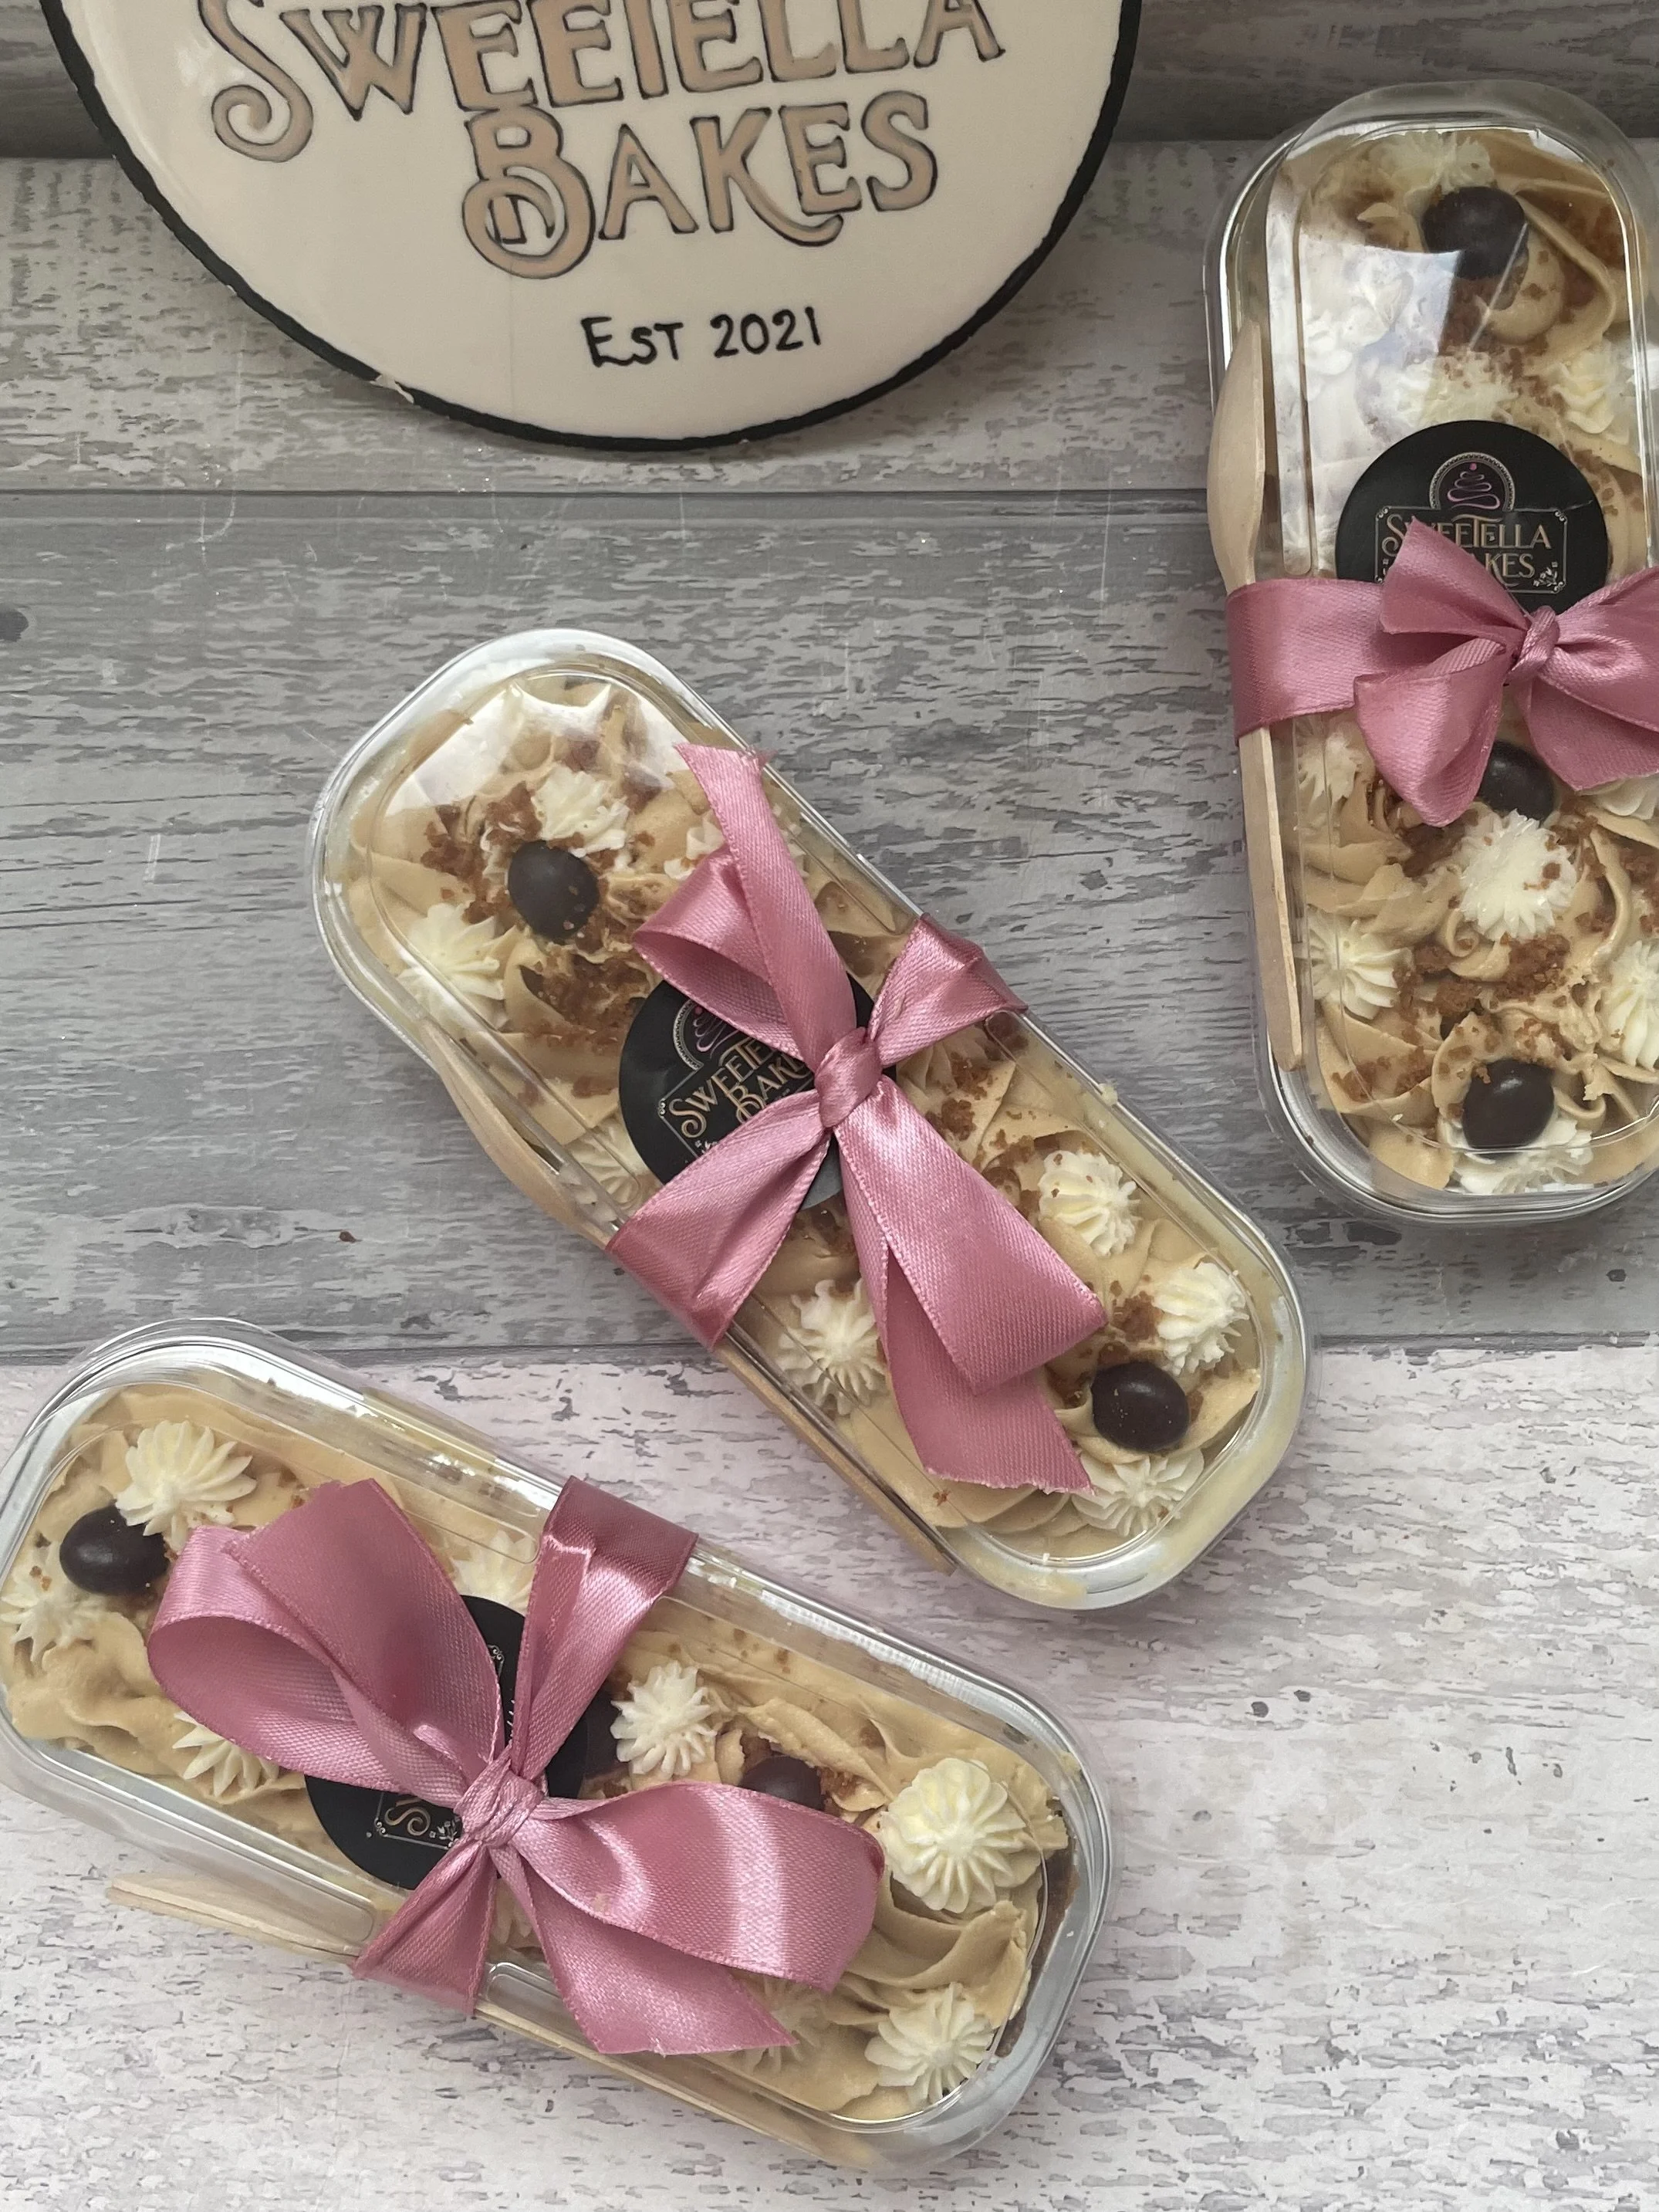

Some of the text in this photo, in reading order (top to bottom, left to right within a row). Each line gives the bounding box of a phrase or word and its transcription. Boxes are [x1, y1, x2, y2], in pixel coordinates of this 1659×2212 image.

[462, 90, 938, 279] BAKES
[710, 306, 822, 358] 2021
[1381, 513, 1552, 557] SEETELLA
[1485, 552, 1536, 587] KES
[668, 1036, 775, 1138] SWEETE
